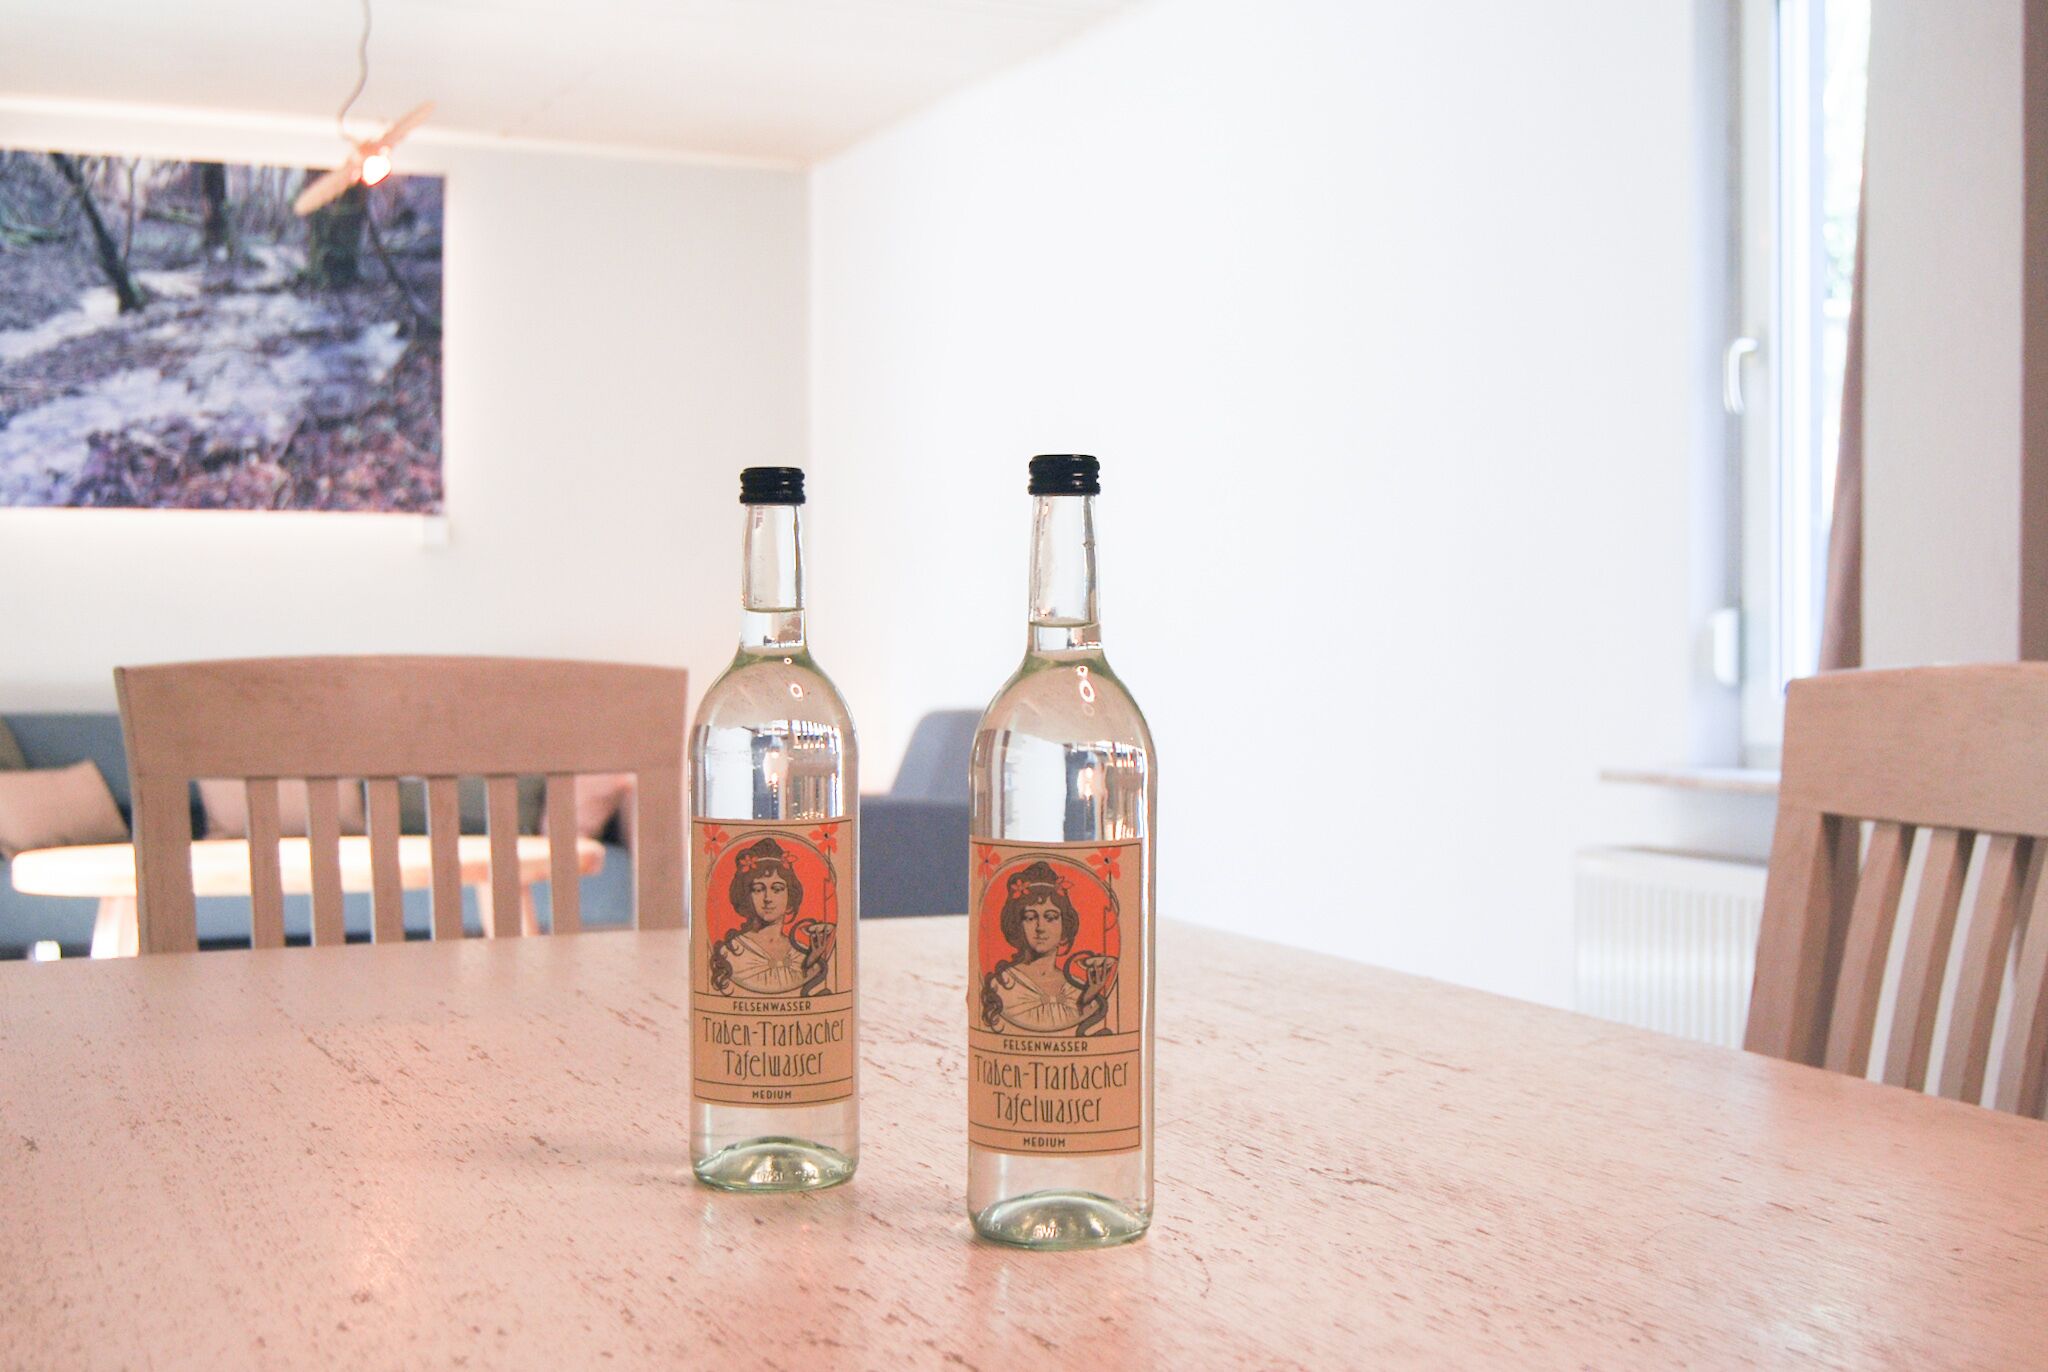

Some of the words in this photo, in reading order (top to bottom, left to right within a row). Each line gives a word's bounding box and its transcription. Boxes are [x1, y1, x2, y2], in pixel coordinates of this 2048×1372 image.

[733, 1000, 811, 1012] FELSENWASSER
[703, 1017, 846, 1047] Traben-Trarbacher
[1003, 1039, 1088, 1052] FELSENWASSER
[722, 1049, 825, 1080] Tafelwasser
[974, 1054, 1129, 1090] Traben-Trarbacher
[752, 1090, 792, 1100] MEDIUM
[993, 1091, 1102, 1126] Tafelwasser
[1023, 1136, 1066, 1148] MEDIUM
